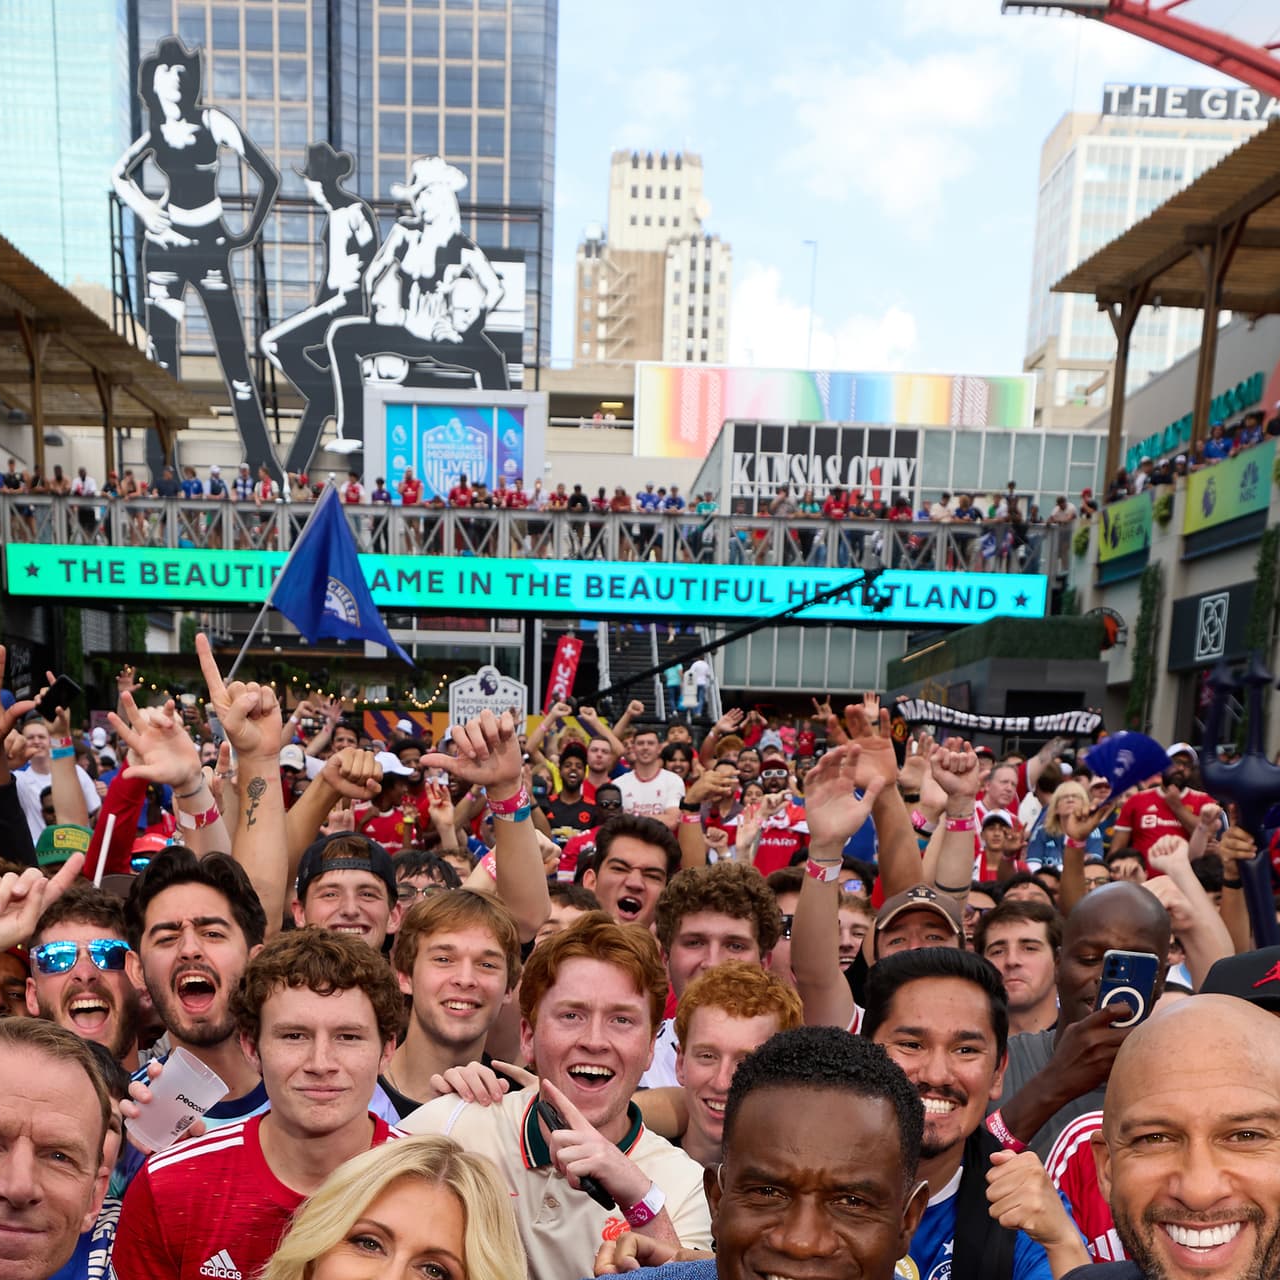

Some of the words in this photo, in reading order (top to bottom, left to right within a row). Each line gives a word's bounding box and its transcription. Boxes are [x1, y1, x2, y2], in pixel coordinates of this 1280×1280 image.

[1104, 83, 1190, 118] THE
[440, 459, 471, 473] LIVE
[732, 452, 842, 499] KANSAS
[847, 455, 917, 506] CITY
[59, 559, 125, 584] THE
[140, 560, 280, 590] BEAUTIF
[370, 568, 444, 594] AME
[458, 572, 493, 595] IN
[505, 572, 572, 598] THE
[596, 575, 774, 604] BEAUTIFUL
[787, 581, 998, 610] HEARTLAND
[457, 698, 488, 706] PREMIER
[897, 698, 1030, 732] MANCHESTER
[1033, 710, 1102, 734] UNITED
[199, 1266, 242, 1280] adidas
